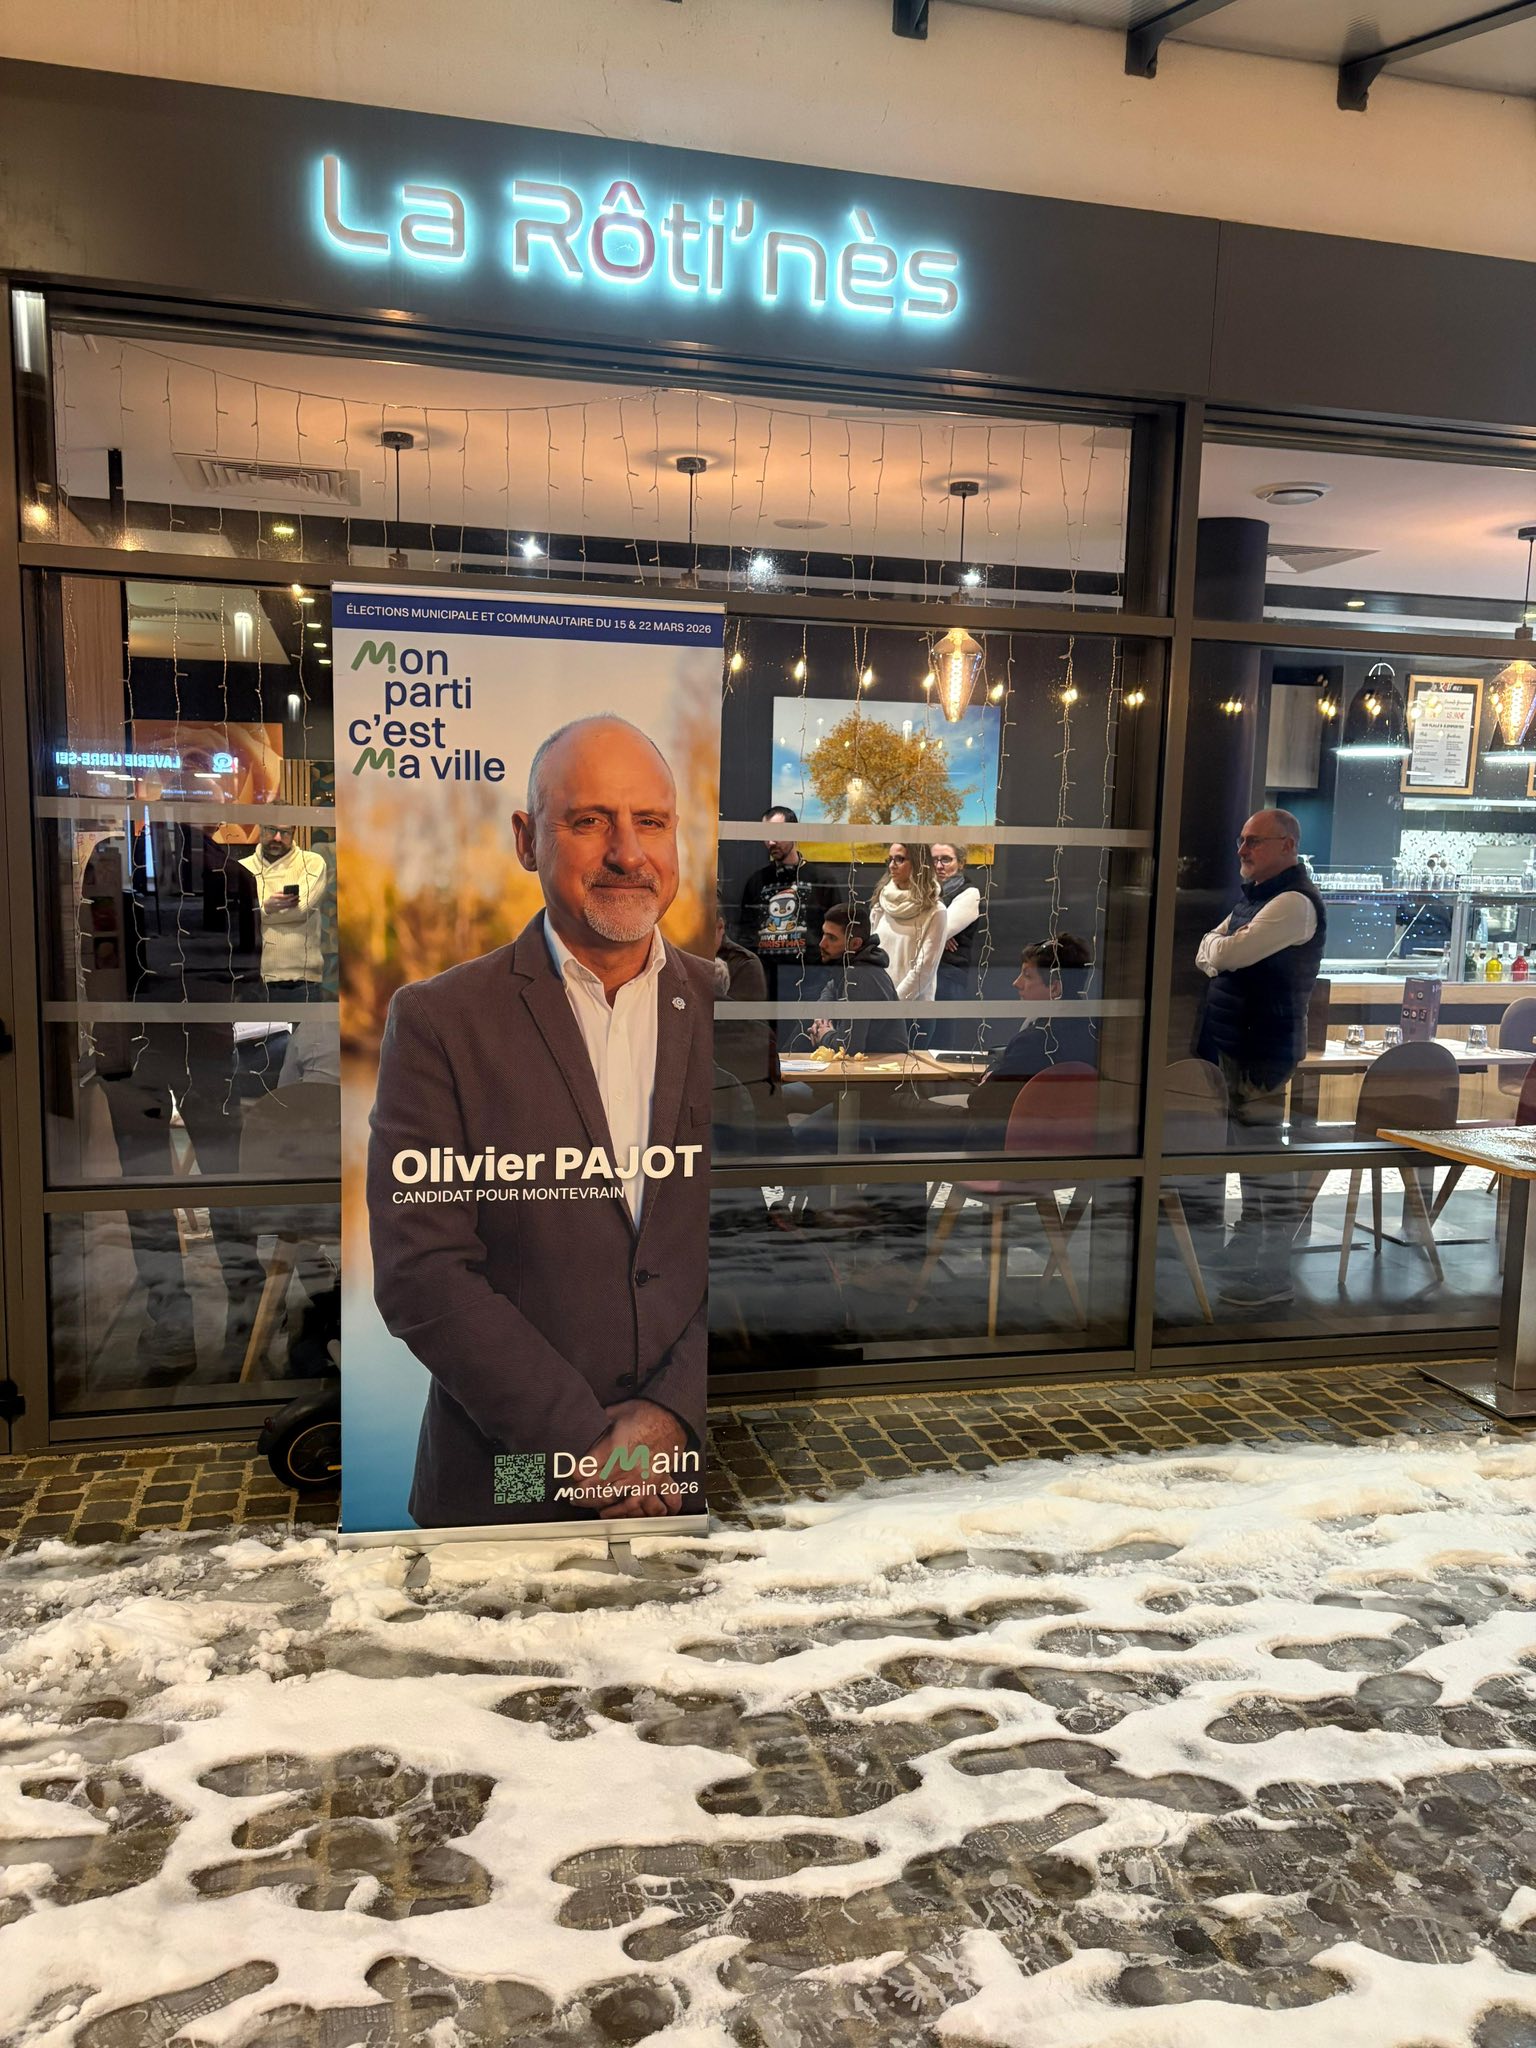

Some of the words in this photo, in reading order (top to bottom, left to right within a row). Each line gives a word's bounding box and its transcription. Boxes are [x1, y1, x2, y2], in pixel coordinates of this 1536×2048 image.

[320, 154, 467, 262] La
[512, 180, 959, 318] Rôti'nès
[346, 603, 410, 618] ÉLECTIONS
[411, 609, 479, 621] MUNICIPALE
[481, 612, 495, 622] ET
[497, 612, 594, 627] COMMUNAUTAIRE
[596, 618, 611, 628] DU
[613, 619, 626, 629] 15
[628, 619, 636, 629] &
[639, 620, 652, 631] 22
[653, 622, 684, 632] MARS
[686, 623, 712, 634] 2026
[351, 640, 449, 676] Mon
[385, 677, 472, 714] parti
[349, 714, 446, 749] c'est
[352, 747, 421, 779] Ma
[431, 749, 505, 782] ville
[392, 1146, 545, 1184] Olivier
[555, 1144, 702, 1180] PAJOT
[392, 1189, 472, 1204] CANDIDAT
[476, 1189, 518, 1202] POUR
[522, 1186, 625, 1200] MONTEVRAIN
[553, 1445, 699, 1480] DeMain
[554, 1481, 656, 1501] Montévrain
[660, 1482, 698, 1495] 2026
